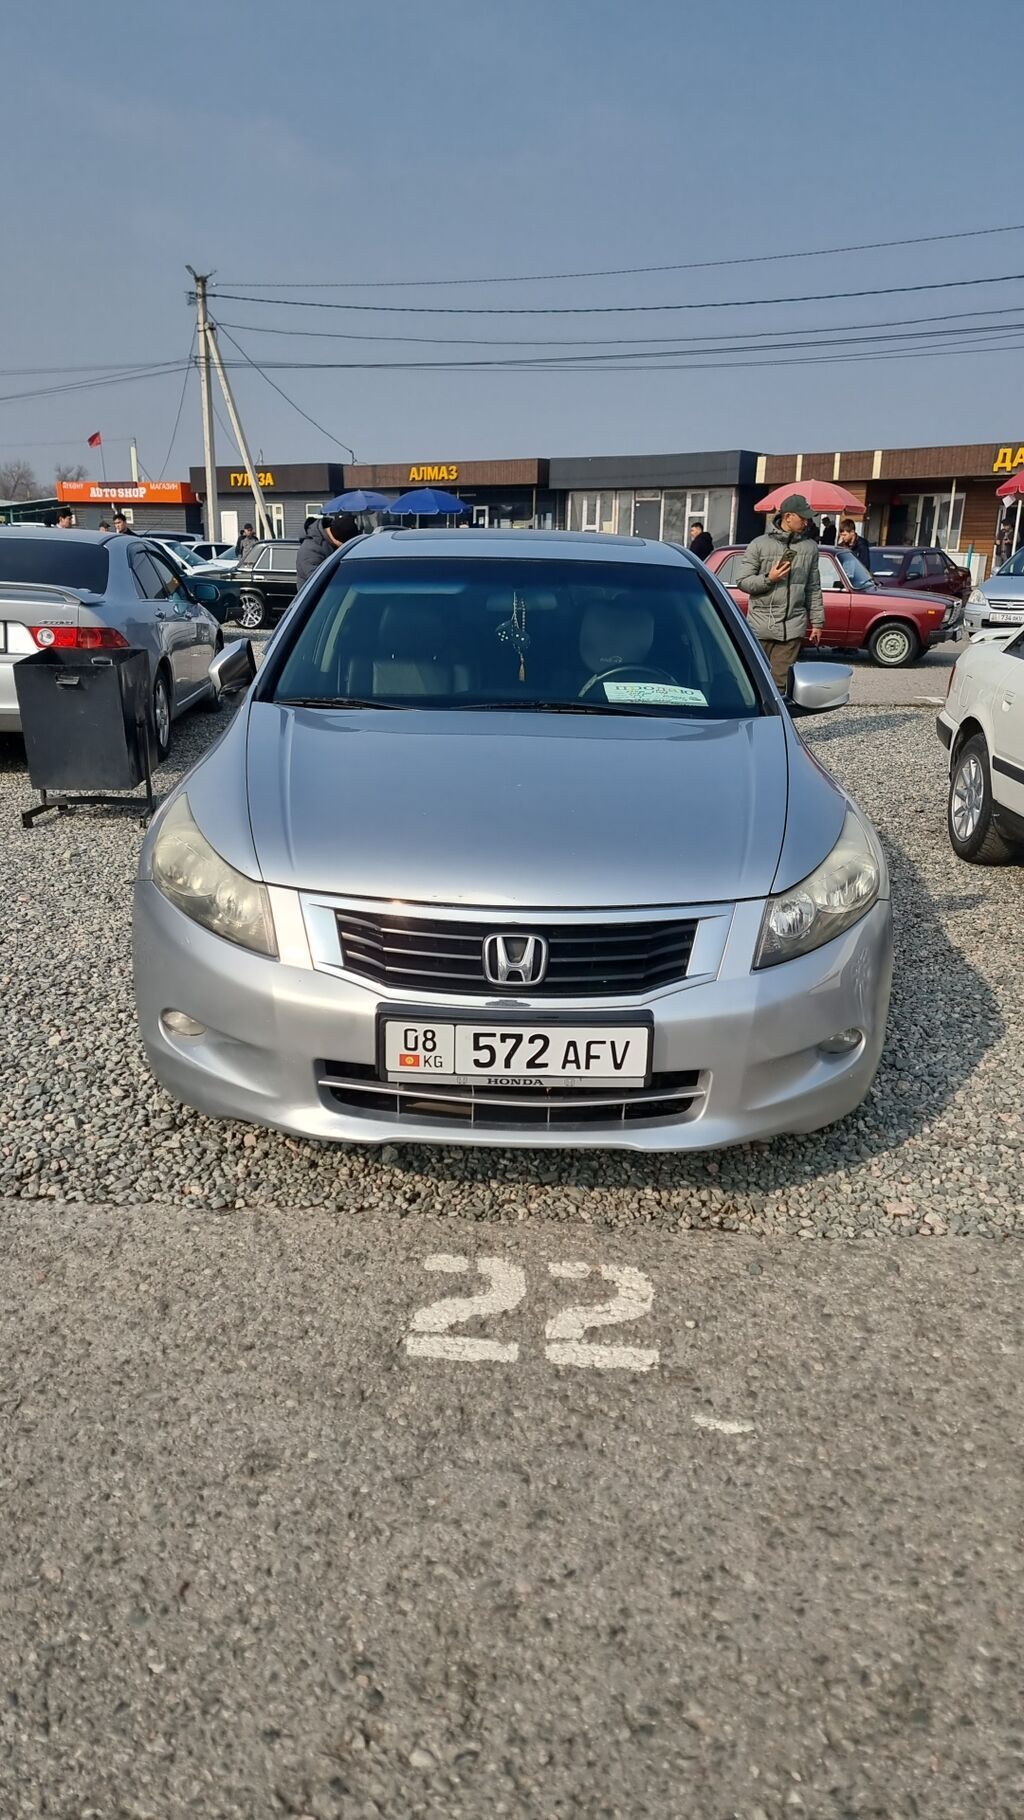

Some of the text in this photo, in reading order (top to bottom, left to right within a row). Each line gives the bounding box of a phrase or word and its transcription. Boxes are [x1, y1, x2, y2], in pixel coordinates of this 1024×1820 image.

[230, 472, 274, 487] ГУЛЗА
[409, 465, 458, 481] АЛМАЗ
[89, 487, 147, 498] AUTO SHOP
[149, 483, 178, 491] МАГАЗИН
[404, 1028, 437, 1052] 08
[473, 1032, 630, 1070] 572 AFV
[423, 1055, 443, 1068] KG
[487, 1078, 544, 1086] HONDA
[406, 1254, 660, 1372] 22
